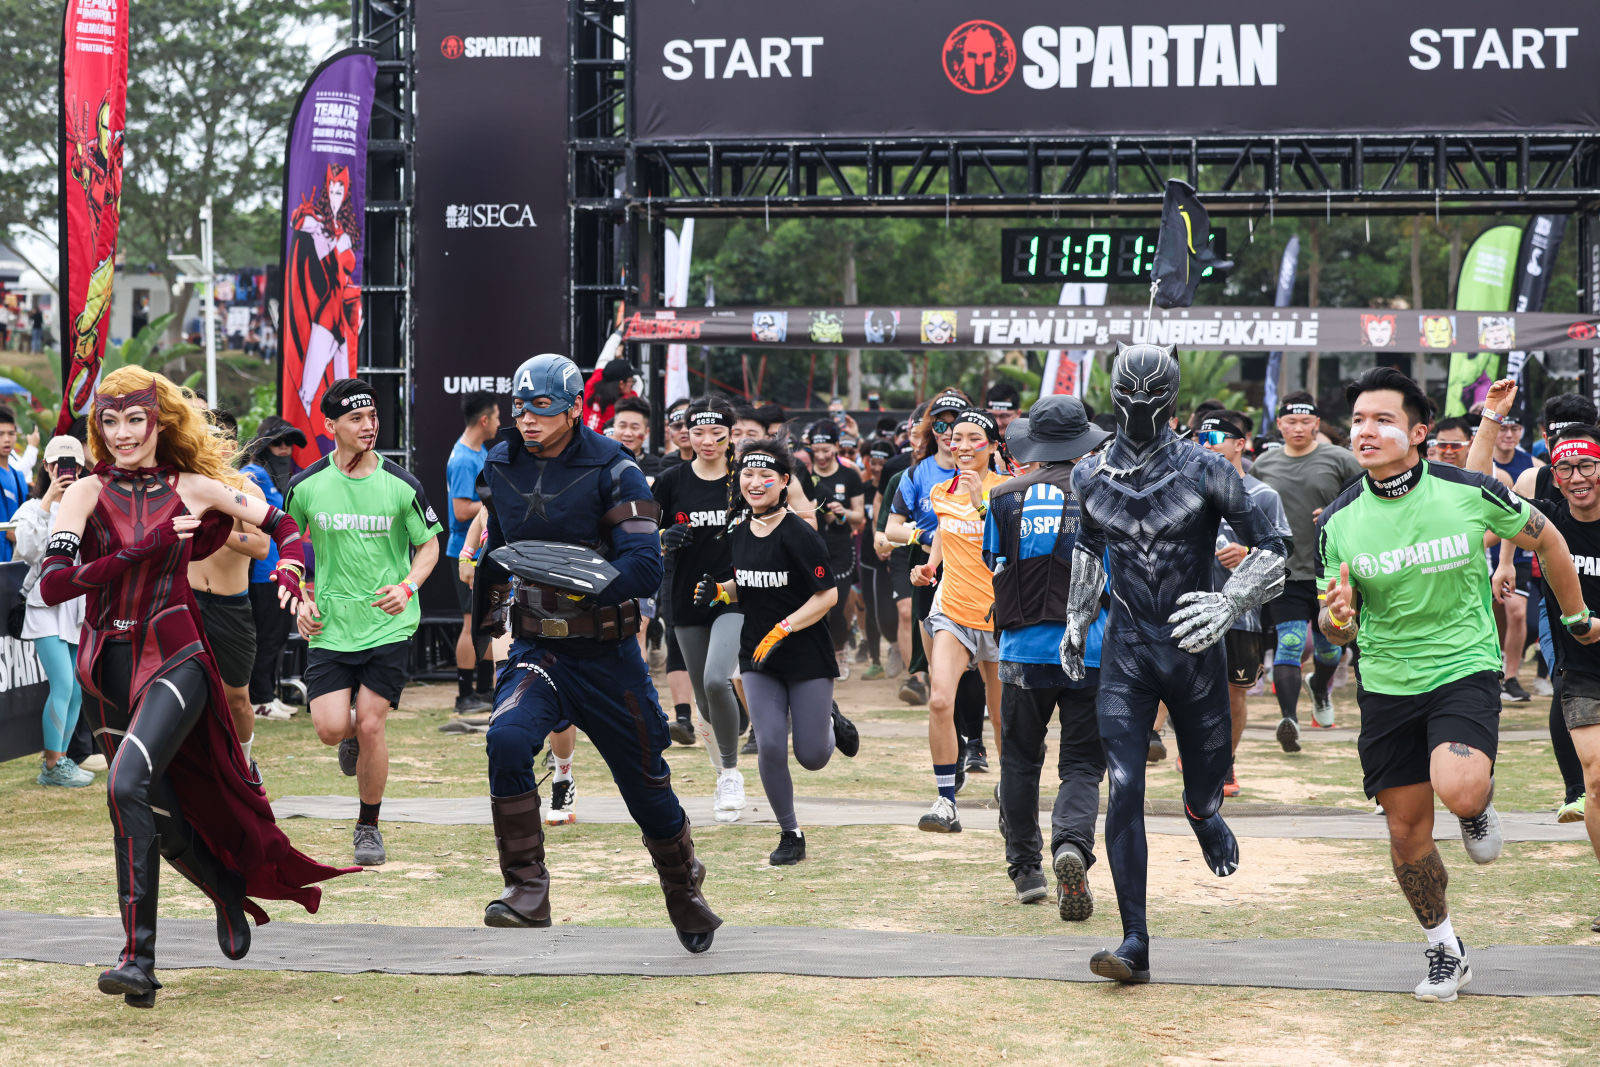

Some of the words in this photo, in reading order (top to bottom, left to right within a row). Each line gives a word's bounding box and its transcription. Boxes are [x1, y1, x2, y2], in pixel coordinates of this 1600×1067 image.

[464, 36, 541, 58] SPARTAN
[1408, 27, 1579, 71] START
[662, 36, 824, 81] START
[315, 103, 343, 117] TEAM
[473, 203, 537, 228] SECA
[970, 318, 1053, 344] TEAM
[1054, 318, 1098, 344] UP
[1109, 319, 1131, 335] BE
[1132, 319, 1319, 346] UNBREAKABLE
[696, 411, 723, 420] SPARTAN
[696, 418, 716, 426] 6655
[1555, 442, 1588, 454] SPARTAN
[1560, 449, 1578, 459] 204
[748, 453, 775, 464] SPARTAN
[1383, 469, 1413, 489] SPARTAN
[1385, 484, 1409, 497] 7620
[49, 541, 74, 552] 6872
[1379, 532, 1470, 575] SPARTAN
[736, 568, 789, 588] SPARTAN
